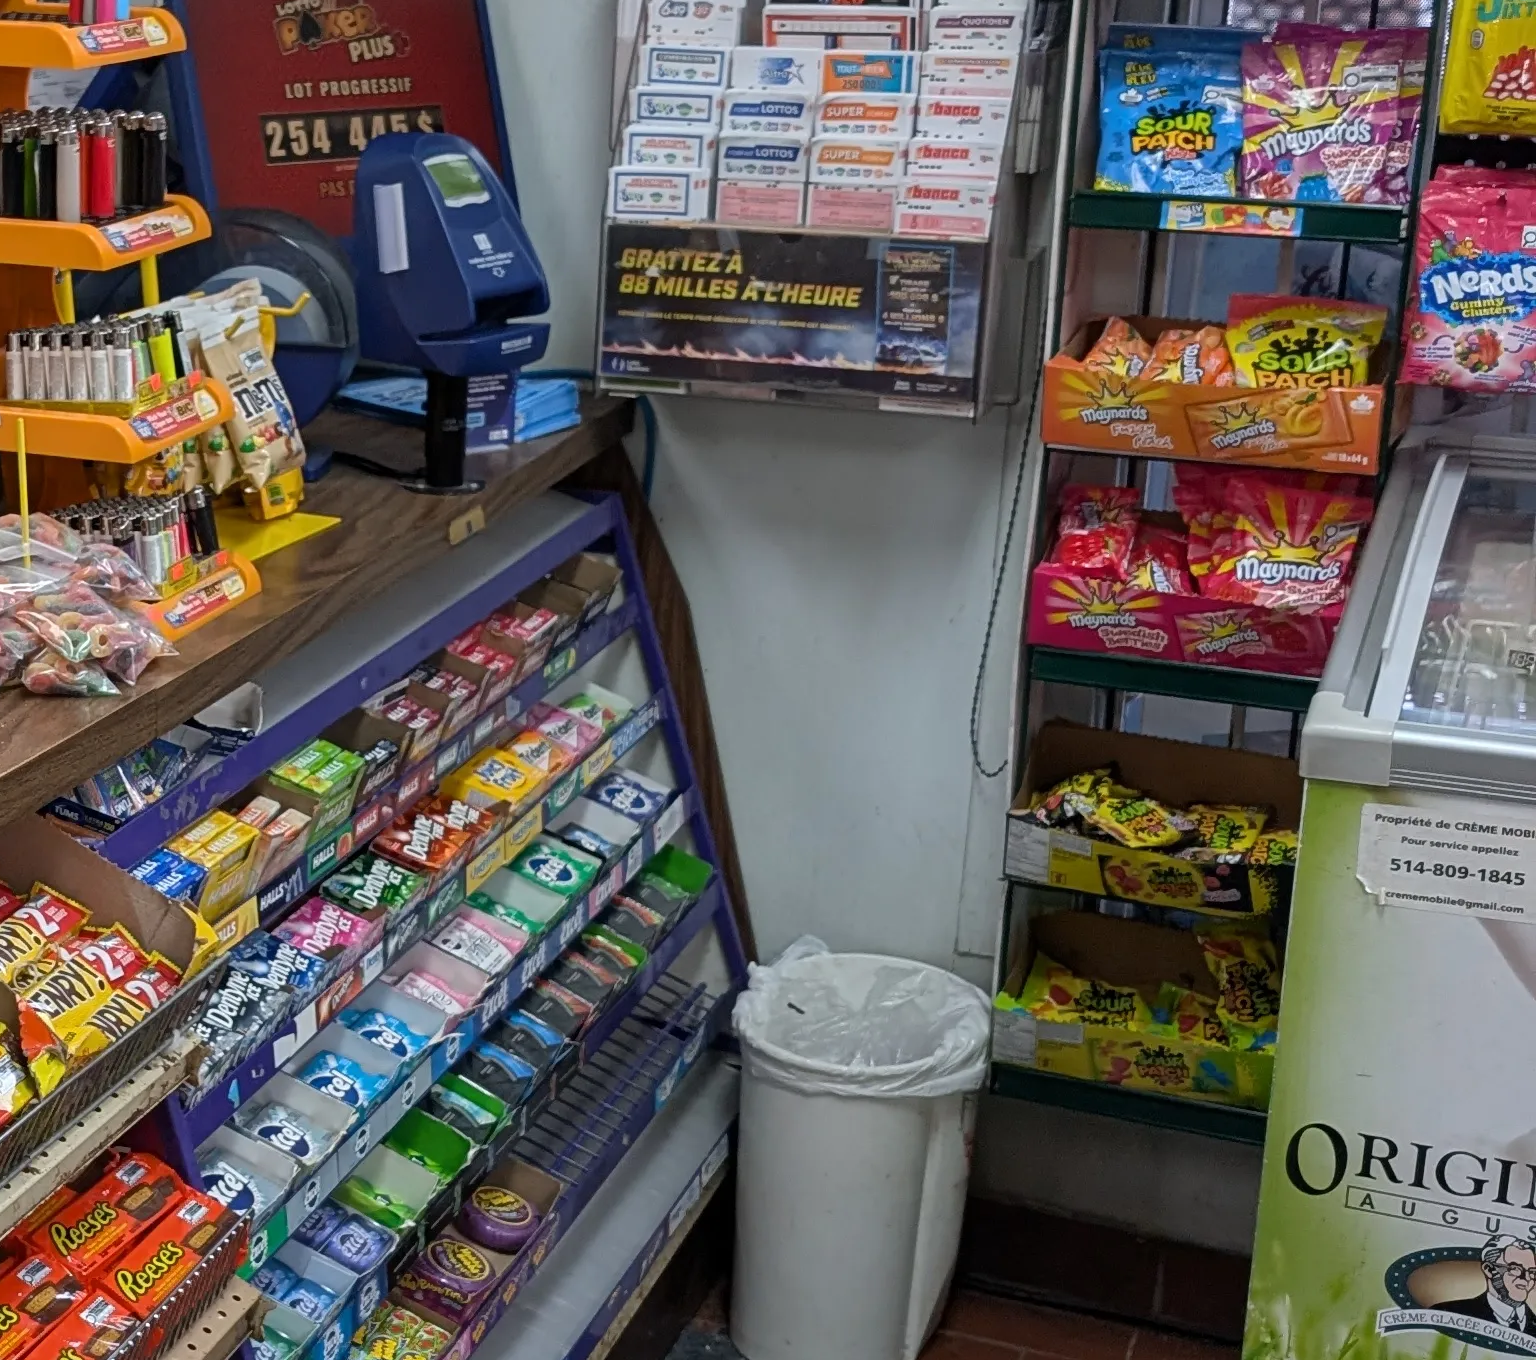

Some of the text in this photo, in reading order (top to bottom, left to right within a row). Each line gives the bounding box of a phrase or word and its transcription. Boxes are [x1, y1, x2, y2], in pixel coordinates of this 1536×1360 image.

[348, 35, 396, 63] PLUS
[285, 77, 413, 99] LOT PROGRESSIF
[762, 105, 800, 115] LOTTOS
[826, 106, 864, 117] SUPER
[1135, 110, 1211, 135] SOUR
[265, 116, 331, 158] 254
[1131, 131, 1214, 153] PATCH
[1260, 120, 1372, 160] Maynards
[756, 148, 795, 159] LOTTOS
[822, 149, 861, 161] SUPER
[621, 248, 743, 274] GRATTEZ À
[619, 273, 650, 294] 88
[654, 277, 739, 300] MILLES
[764, 282, 862, 308] L'HEURE
[1450, 298, 1506, 312] Gummy
[1256, 350, 1349, 375] SOUR
[1256, 368, 1352, 389] PATCH
[1079, 405, 1149, 422] Maynards
[1210, 420, 1276, 449] Maynards
[1235, 556, 1341, 585] Maynards
[1068, 612, 1136, 629] Maynards
[1197, 627, 1260, 654] Maynards
[54, 803, 80, 821] TUMS
[1375, 813, 1498, 835] Propriété de CRÈME
[1400, 835, 1519, 857] Pour service appellez
[353, 855, 397, 912] Dentyne
[1389, 857, 1526, 886] 514-809-1845
[1385, 890, 1524, 914] crememobile@gmail.com
[303, 902, 347, 956] Dentyne
[50, 1202, 119, 1258] Reese's
[115, 1241, 185, 1304] Reese's
[1382, 1309, 1481, 1332] CRÈME GLACÉE
